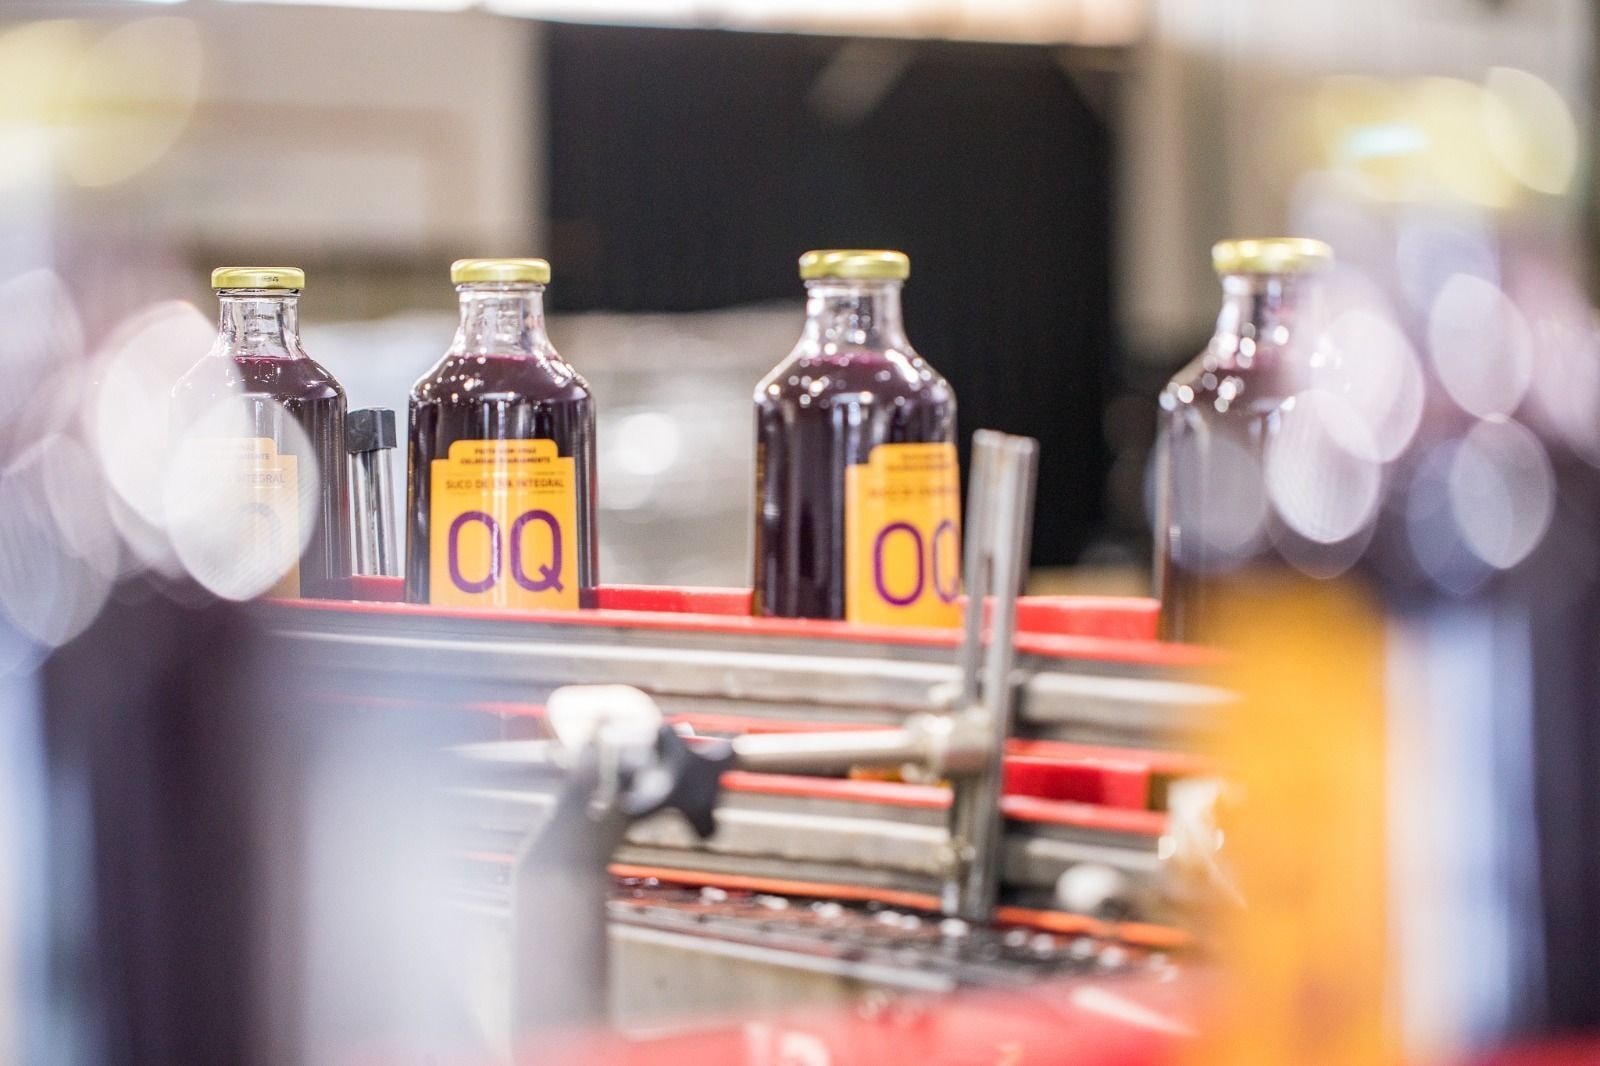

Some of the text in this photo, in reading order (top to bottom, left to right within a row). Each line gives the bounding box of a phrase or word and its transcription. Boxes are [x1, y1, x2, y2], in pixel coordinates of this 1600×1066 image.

[446, 480, 472, 489] SUCO
[475, 479, 488, 488] DE
[516, 478, 565, 488] INTEGRAL
[448, 510, 564, 594] OQ
